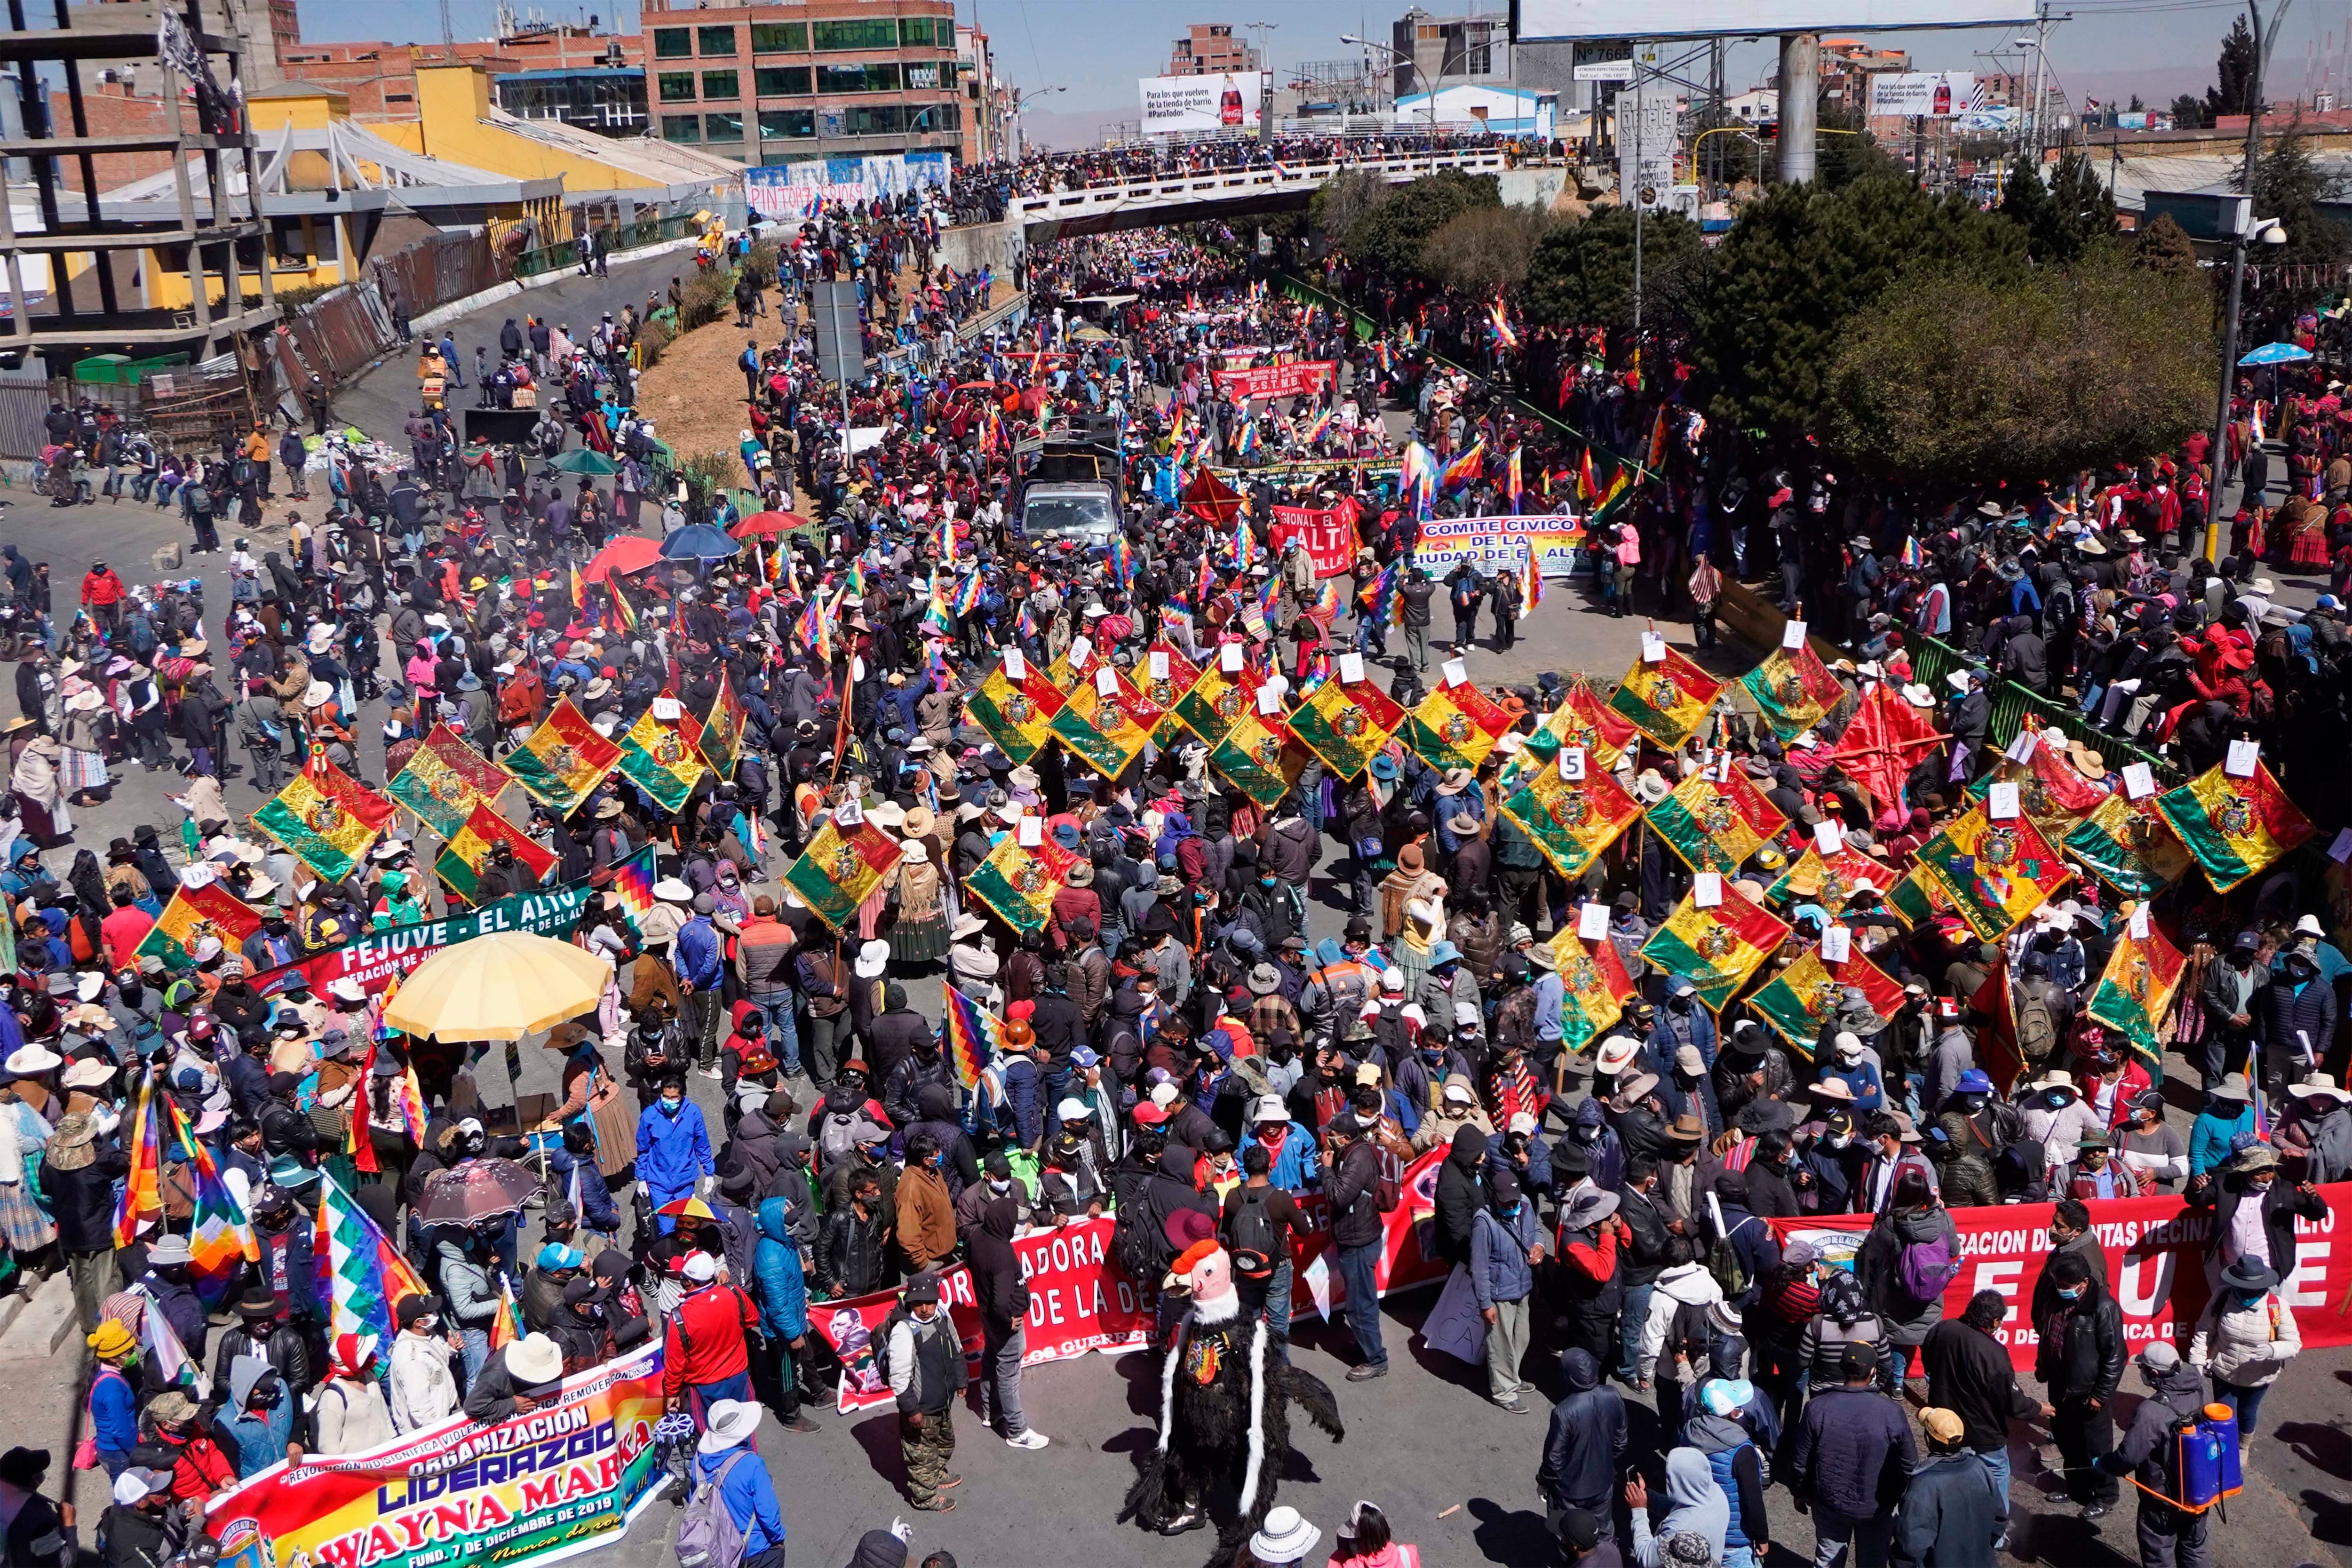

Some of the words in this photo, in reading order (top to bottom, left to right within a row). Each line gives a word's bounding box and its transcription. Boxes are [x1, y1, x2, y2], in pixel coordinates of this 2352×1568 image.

[1598, 48, 1630, 60] 7665
[1157, 100, 1162, 108] la
[1163, 99, 1183, 108] tienda
[1184, 98, 1192, 106] de
[1193, 97, 1213, 106] barrio.
[1172, 91, 1184, 100] que
[1185, 88, 1208, 97] vuelven
[1148, 110, 1184, 118] #ParaTodos
[1281, 370, 1303, 378] BOLIVIA
[1290, 363, 1332, 372] TRABAJADORES
[1323, 514, 1336, 526] EL
[1425, 521, 1500, 536] COMITE
[1507, 518, 1575, 532] CIVICO
[1297, 523, 1346, 551] ALTO
[1472, 536, 1496, 546] DE
[1503, 535, 1527, 546] LA
[1485, 549, 1511, 559] DE
[1547, 548, 1591, 558] ALTO
[1565, 755, 1579, 774] 5
[838, 804, 860, 823] 4
[498, 825, 519, 851] DISTRITO
[342, 922, 447, 971] FEJUVE
[479, 907, 510, 934] EL
[520, 885, 575, 923] ALTO
[403, 953, 417, 968] DE
[539, 918, 551, 931] DE
[555, 914, 566, 926] EL
[569, 906, 585, 921] ALT
[1845, 1237, 1859, 1247] ALTO
[1030, 1288, 1065, 1328] DE
[1077, 1279, 1109, 1319] LA
[2161, 1321, 2187, 1338] DE
[363, 1458, 381, 1470] NO
[384, 1440, 440, 1465] SIGNIFICA
[563, 1377, 611, 1404] REMOVER
[409, 1404, 589, 1478] ORGANIZACIÓN
[378, 1419, 616, 1514] LIDERAZGO
[318, 1494, 509, 1568] WAYNA
[522, 1420, 653, 1516] MARKA
[408, 1548, 448, 1568] FUND.
[452, 1543, 460, 1557] 7
[465, 1539, 482, 1555] DE
[486, 1514, 555, 1548] DICIEMBRE
[558, 1506, 576, 1523] DE
[578, 1496, 612, 1516] 2019
[491, 1536, 560, 1560] Nunca
[565, 1522, 588, 1540] de
